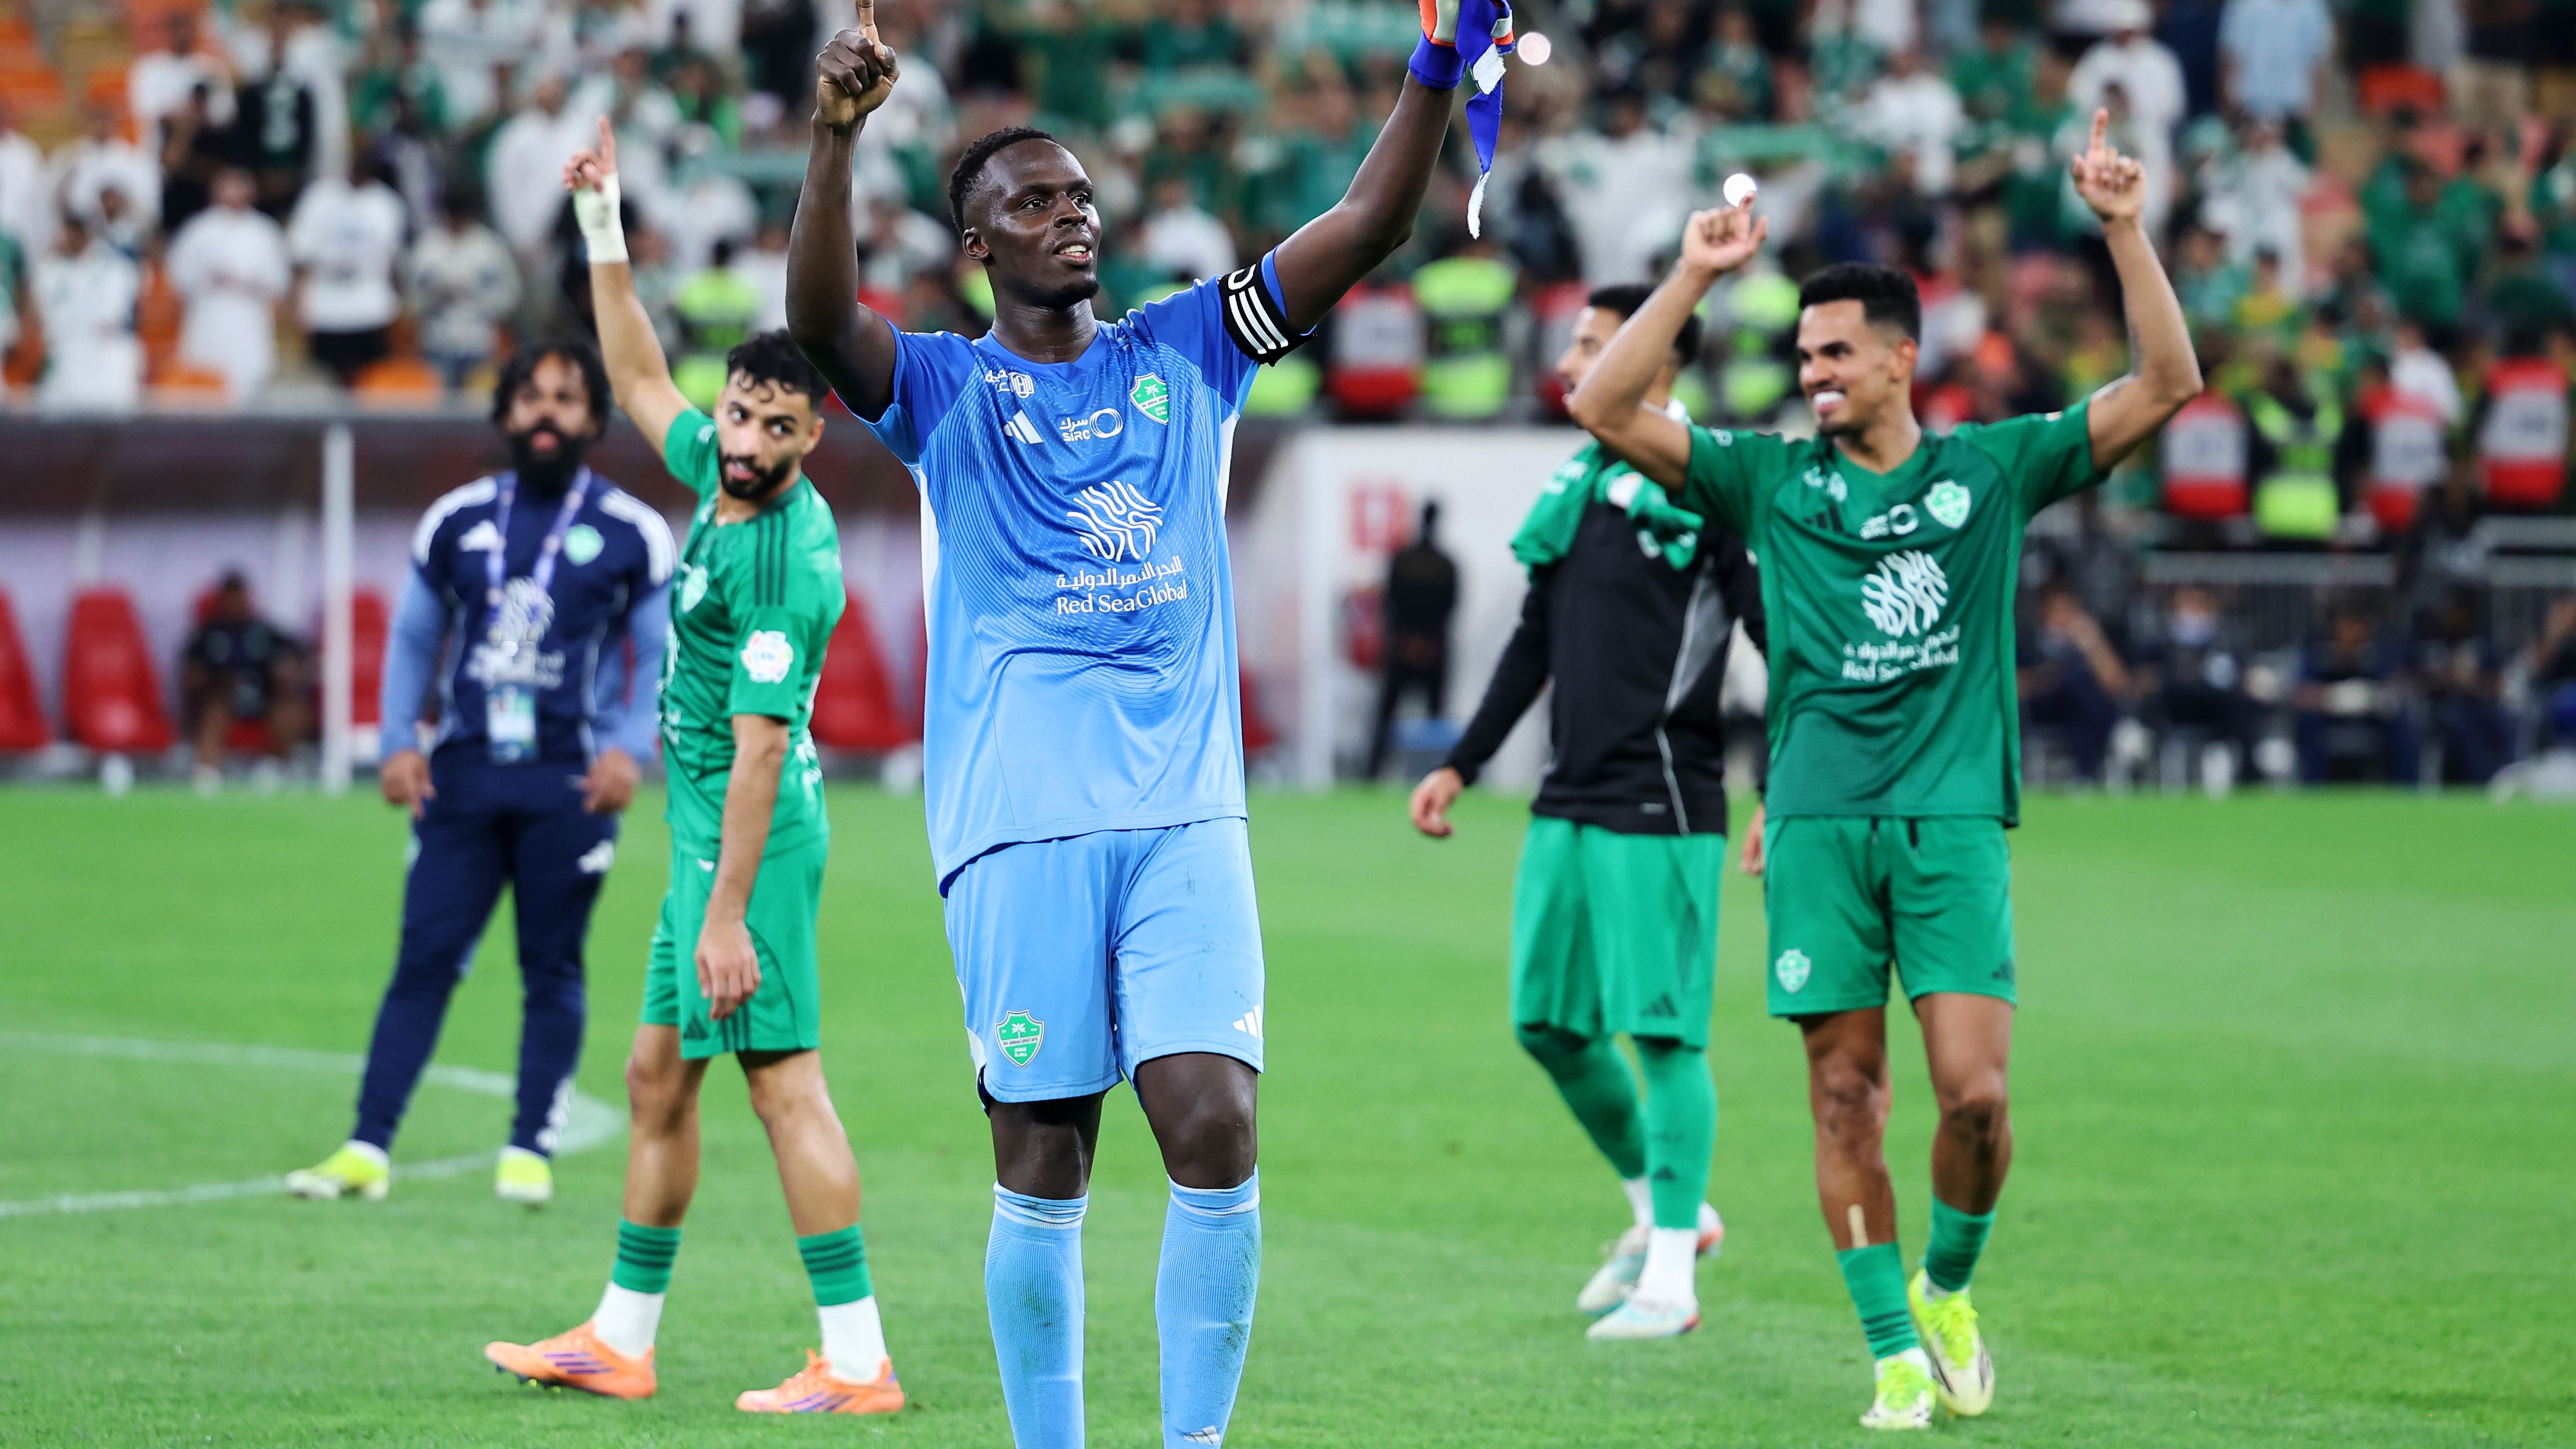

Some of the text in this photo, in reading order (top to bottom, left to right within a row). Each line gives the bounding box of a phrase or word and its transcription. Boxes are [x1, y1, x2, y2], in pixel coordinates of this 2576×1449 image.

[1062, 429, 1091, 441] SIRC
[1056, 568, 1117, 591] الدولية
[1156, 555, 1184, 581] البحر
[1057, 579, 1188, 615] Red Sea Global
